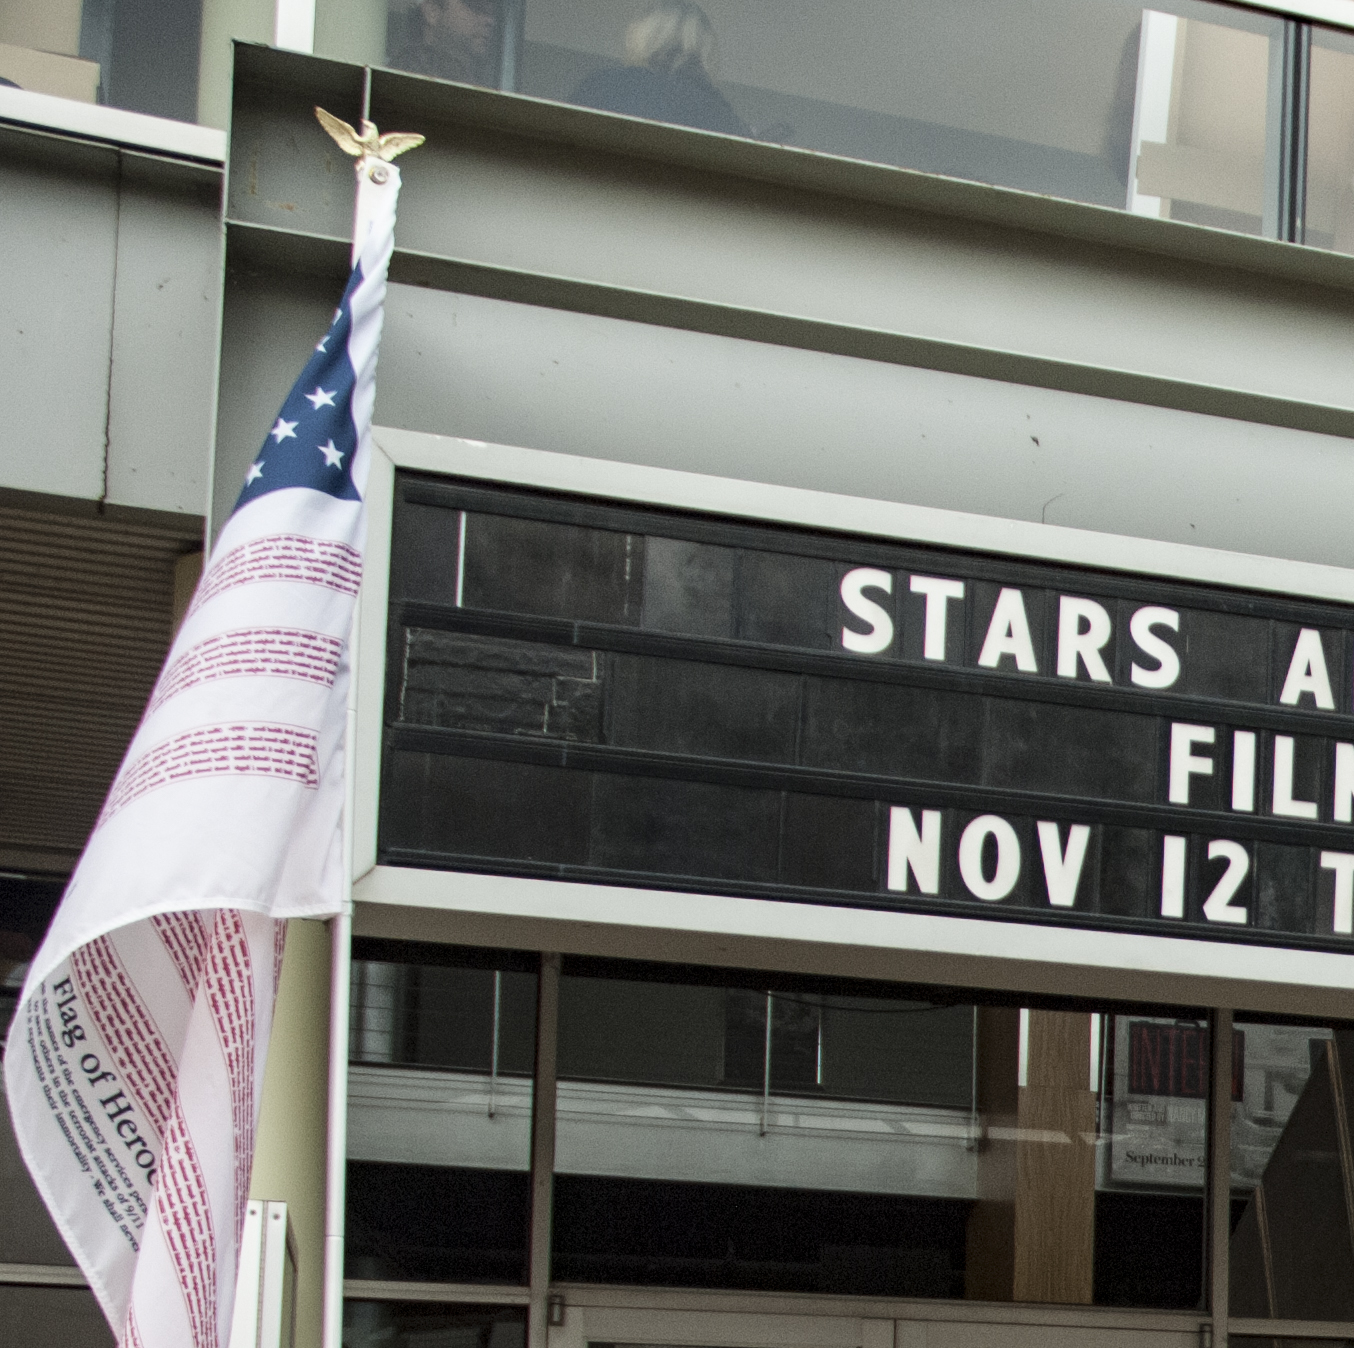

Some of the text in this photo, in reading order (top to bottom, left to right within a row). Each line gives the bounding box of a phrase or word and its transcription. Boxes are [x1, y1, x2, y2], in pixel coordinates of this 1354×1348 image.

[841, 568, 1179, 688] STARS
[888, 807, 1089, 906] NOV
[1162, 836, 1248, 923] 12
[53, 975, 86, 1048] Flag
[81, 1053, 117, 1087] of
[40, 1040, 55, 1074] others
[53, 1077, 60, 1088] in
[59, 1090, 70, 1107] the
[69, 1110, 96, 1153] terrorist
[93, 1155, 118, 1191] attacks
[117, 1193, 130, 1204] of
[125, 1205, 144, 1229] 9/11
[45, 1018, 59, 1052] names
[58, 1055, 68, 1066] of
[63, 1068, 74, 1085] the
[72, 1089, 106, 1144] emergency
[104, 1148, 133, 1188] services
[1126, 1150, 1195, 1167] September
[55, 1112, 92, 1172] immortality
[94, 1180, 105, 1196] We
[103, 1199, 124, 1222] shall
